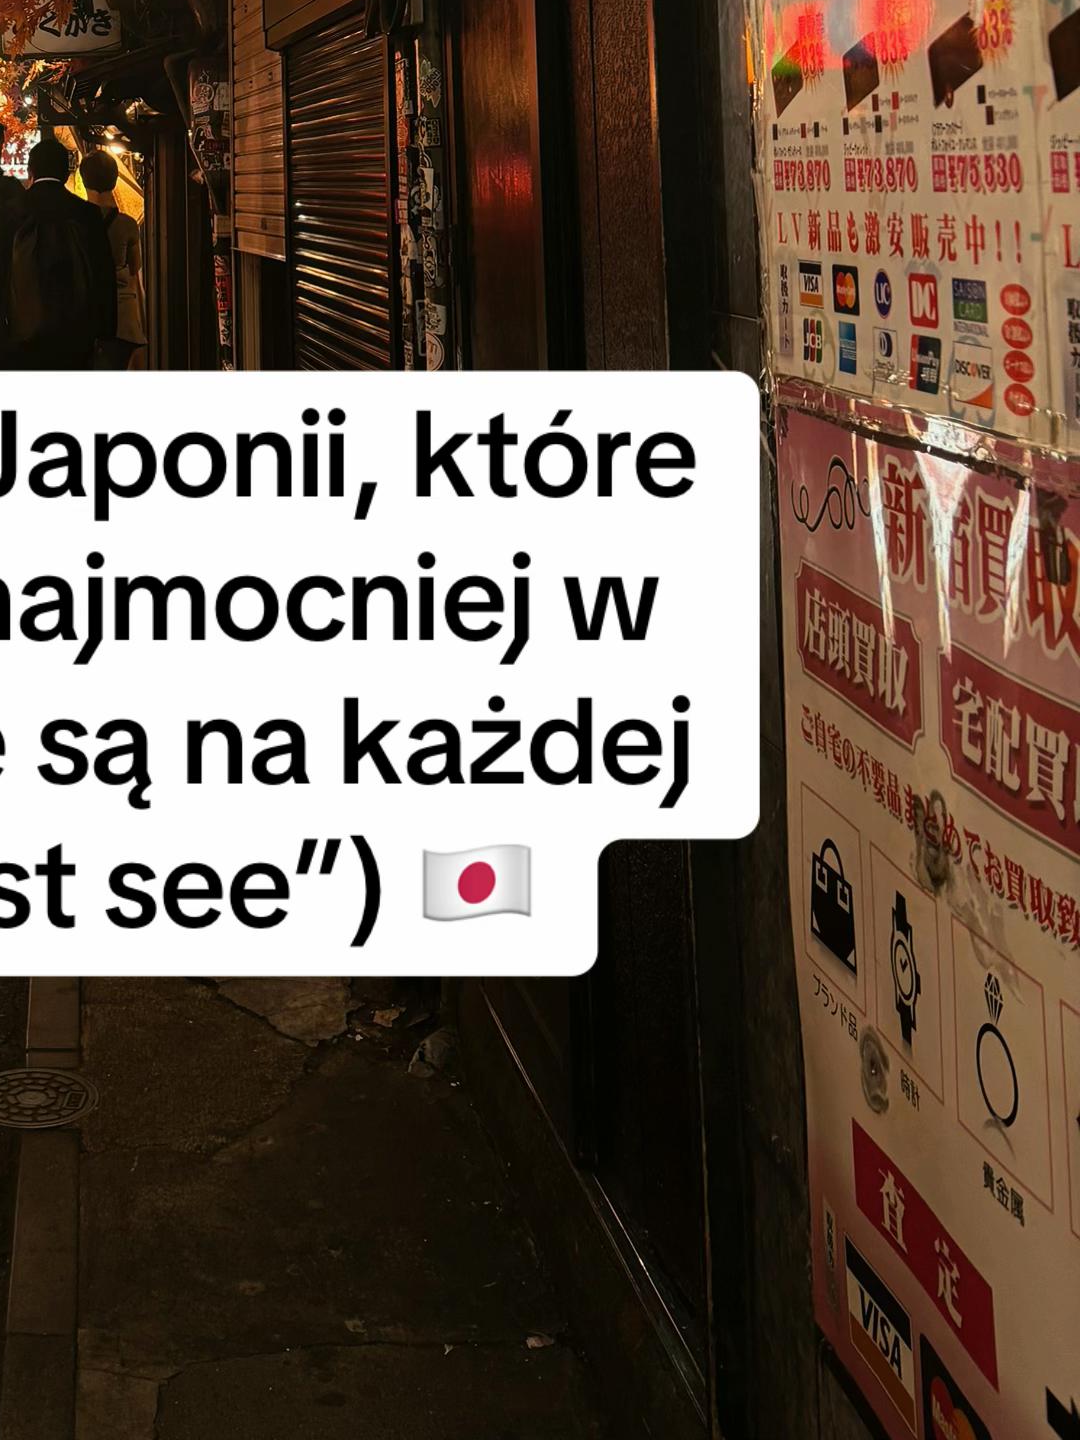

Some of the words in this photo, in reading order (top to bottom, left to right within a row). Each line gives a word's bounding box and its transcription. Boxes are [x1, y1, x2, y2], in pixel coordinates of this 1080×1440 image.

[784, 159, 832, 193] ¥73,870
[856, 155, 919, 193] ¥73,870
[948, 152, 1024, 194] ¥75,530
[803, 274, 820, 294] VISA
[875, 281, 892, 306] UC
[910, 279, 937, 322] DC
[804, 331, 823, 349] JCB
[954, 358, 992, 380] DISCOVER
[803, 587, 910, 714] 店頭買取
[951, 675, 1080, 827] 宅配買
[812, 973, 859, 1042] ブランド品
[900, 1066, 922, 1112] 時計
[982, 1160, 1026, 1228] 貴金属
[878, 1168, 964, 1330] 査定
[857, 1295, 905, 1383] VISA
